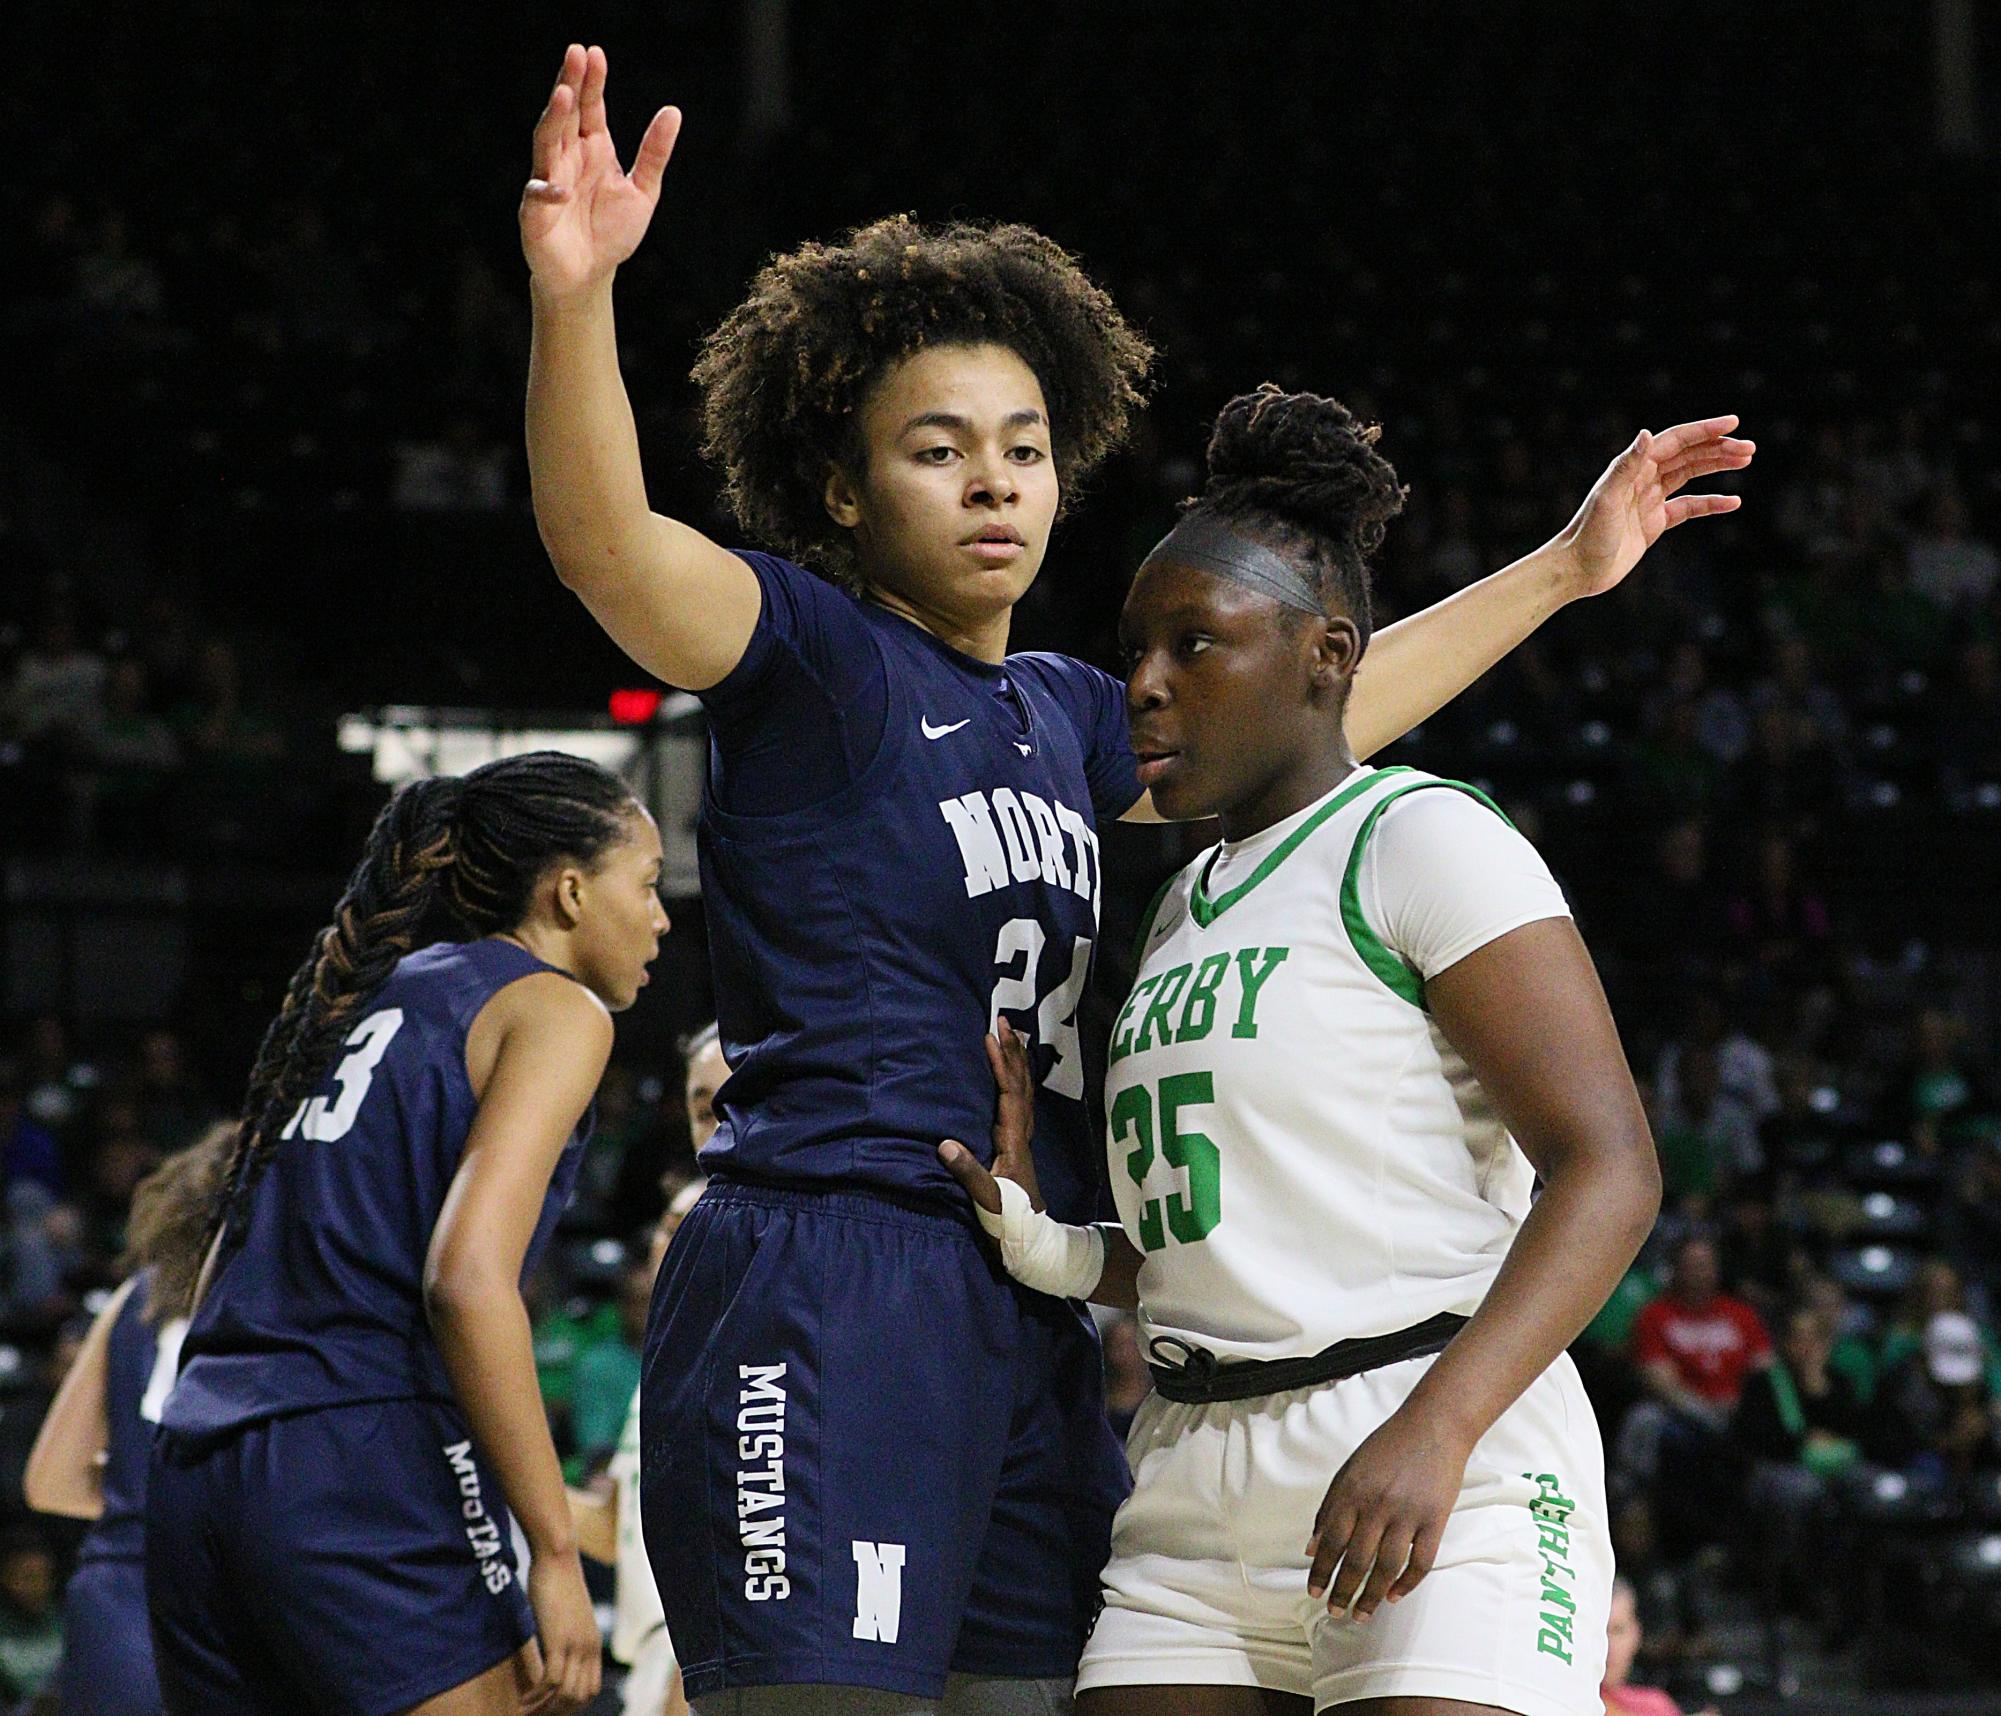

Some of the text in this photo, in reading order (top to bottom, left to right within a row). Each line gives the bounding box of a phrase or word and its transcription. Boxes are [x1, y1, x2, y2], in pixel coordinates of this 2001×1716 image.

[938, 788, 1101, 934] NORT
[278, 1008, 404, 1142] 3
[989, 918, 1093, 1101] 24
[1111, 1071, 1221, 1253] 25
[737, 1362, 791, 1601] MUSTANGS
[852, 1540, 906, 1644] N
